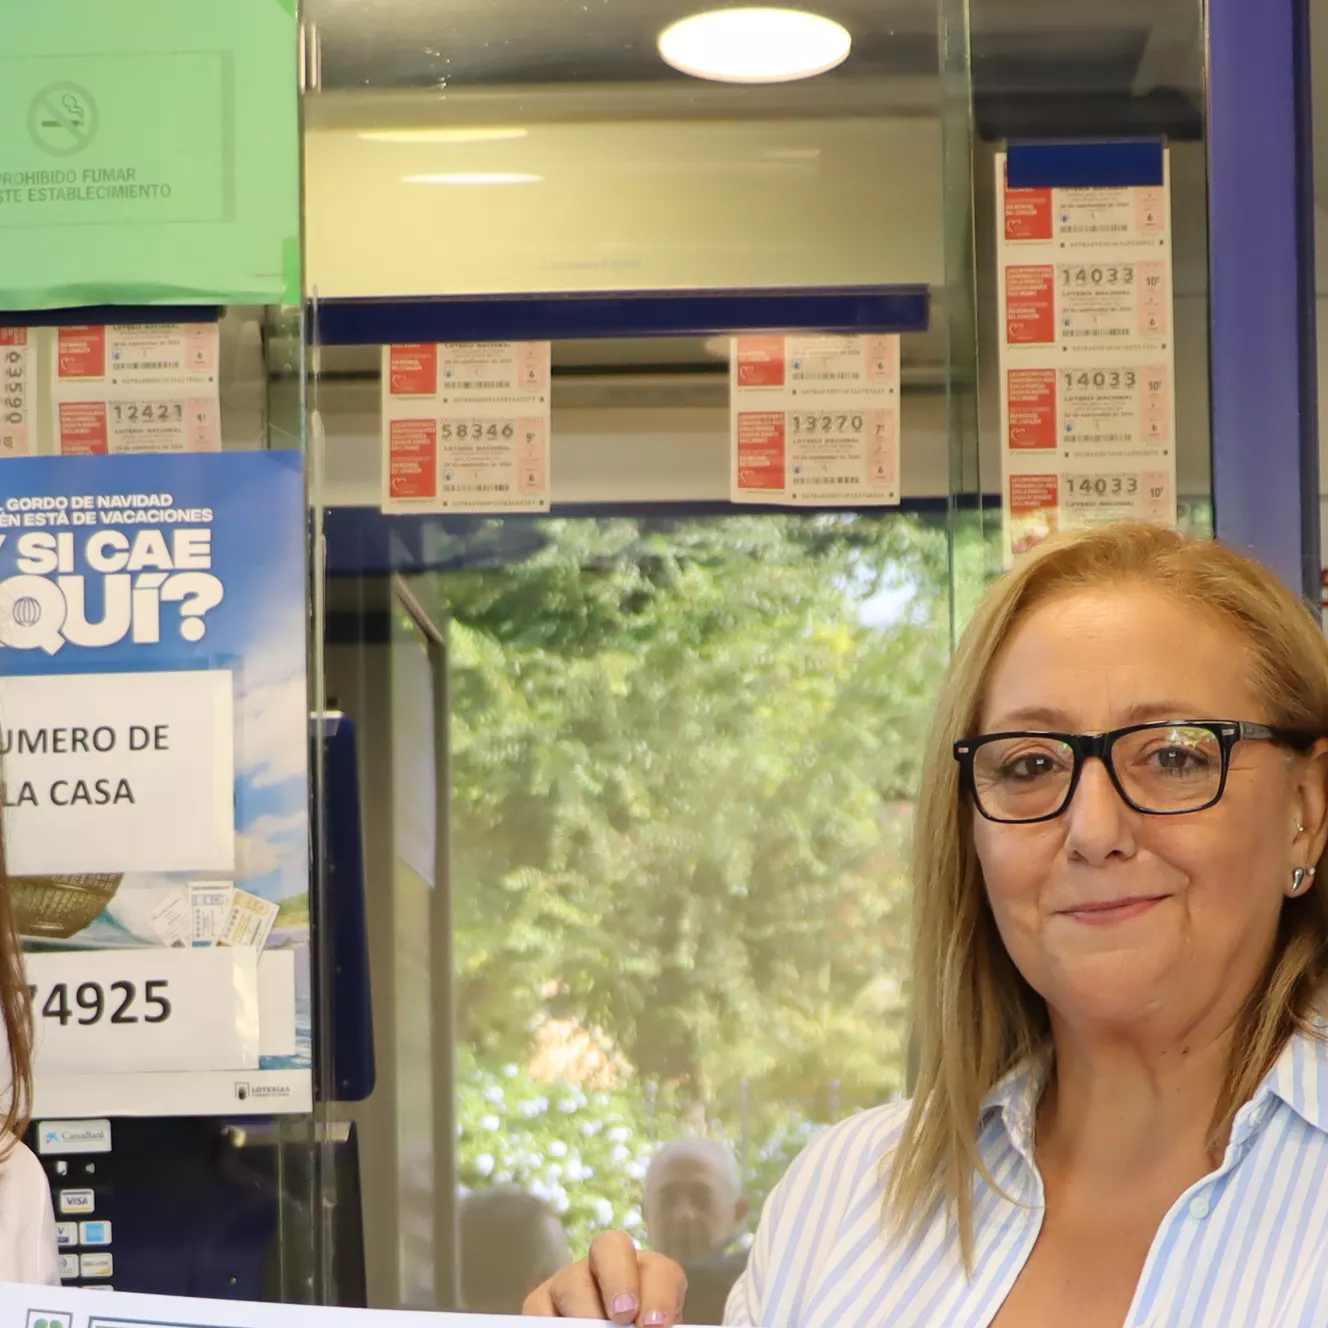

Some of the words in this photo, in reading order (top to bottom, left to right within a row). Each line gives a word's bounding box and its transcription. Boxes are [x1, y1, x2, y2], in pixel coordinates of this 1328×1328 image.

[82, 167, 137, 183] FUMAR
[28, 183, 171, 203] ESTABLECIMIENTO
[1062, 268, 1134, 284] 14033
[1064, 372, 1136, 387] 14033
[114, 404, 183, 420] 12421
[793, 415, 863, 430] 13270
[441, 424, 514, 438] 58346
[1066, 478, 1138, 494] 14033
[7, 497, 67, 511] GORDO
[71, 496, 94, 509] DE
[98, 493, 172, 508] NAVIDAD
[23, 509, 69, 526] ESTÁ
[73, 511, 96, 525] DE
[100, 508, 213, 524] VACACIONES
[17, 531, 74, 575] SI
[86, 528, 212, 573] CAE
[129, 725, 170, 750] DE
[3, 781, 38, 807] LA
[50, 778, 136, 805] CASA
